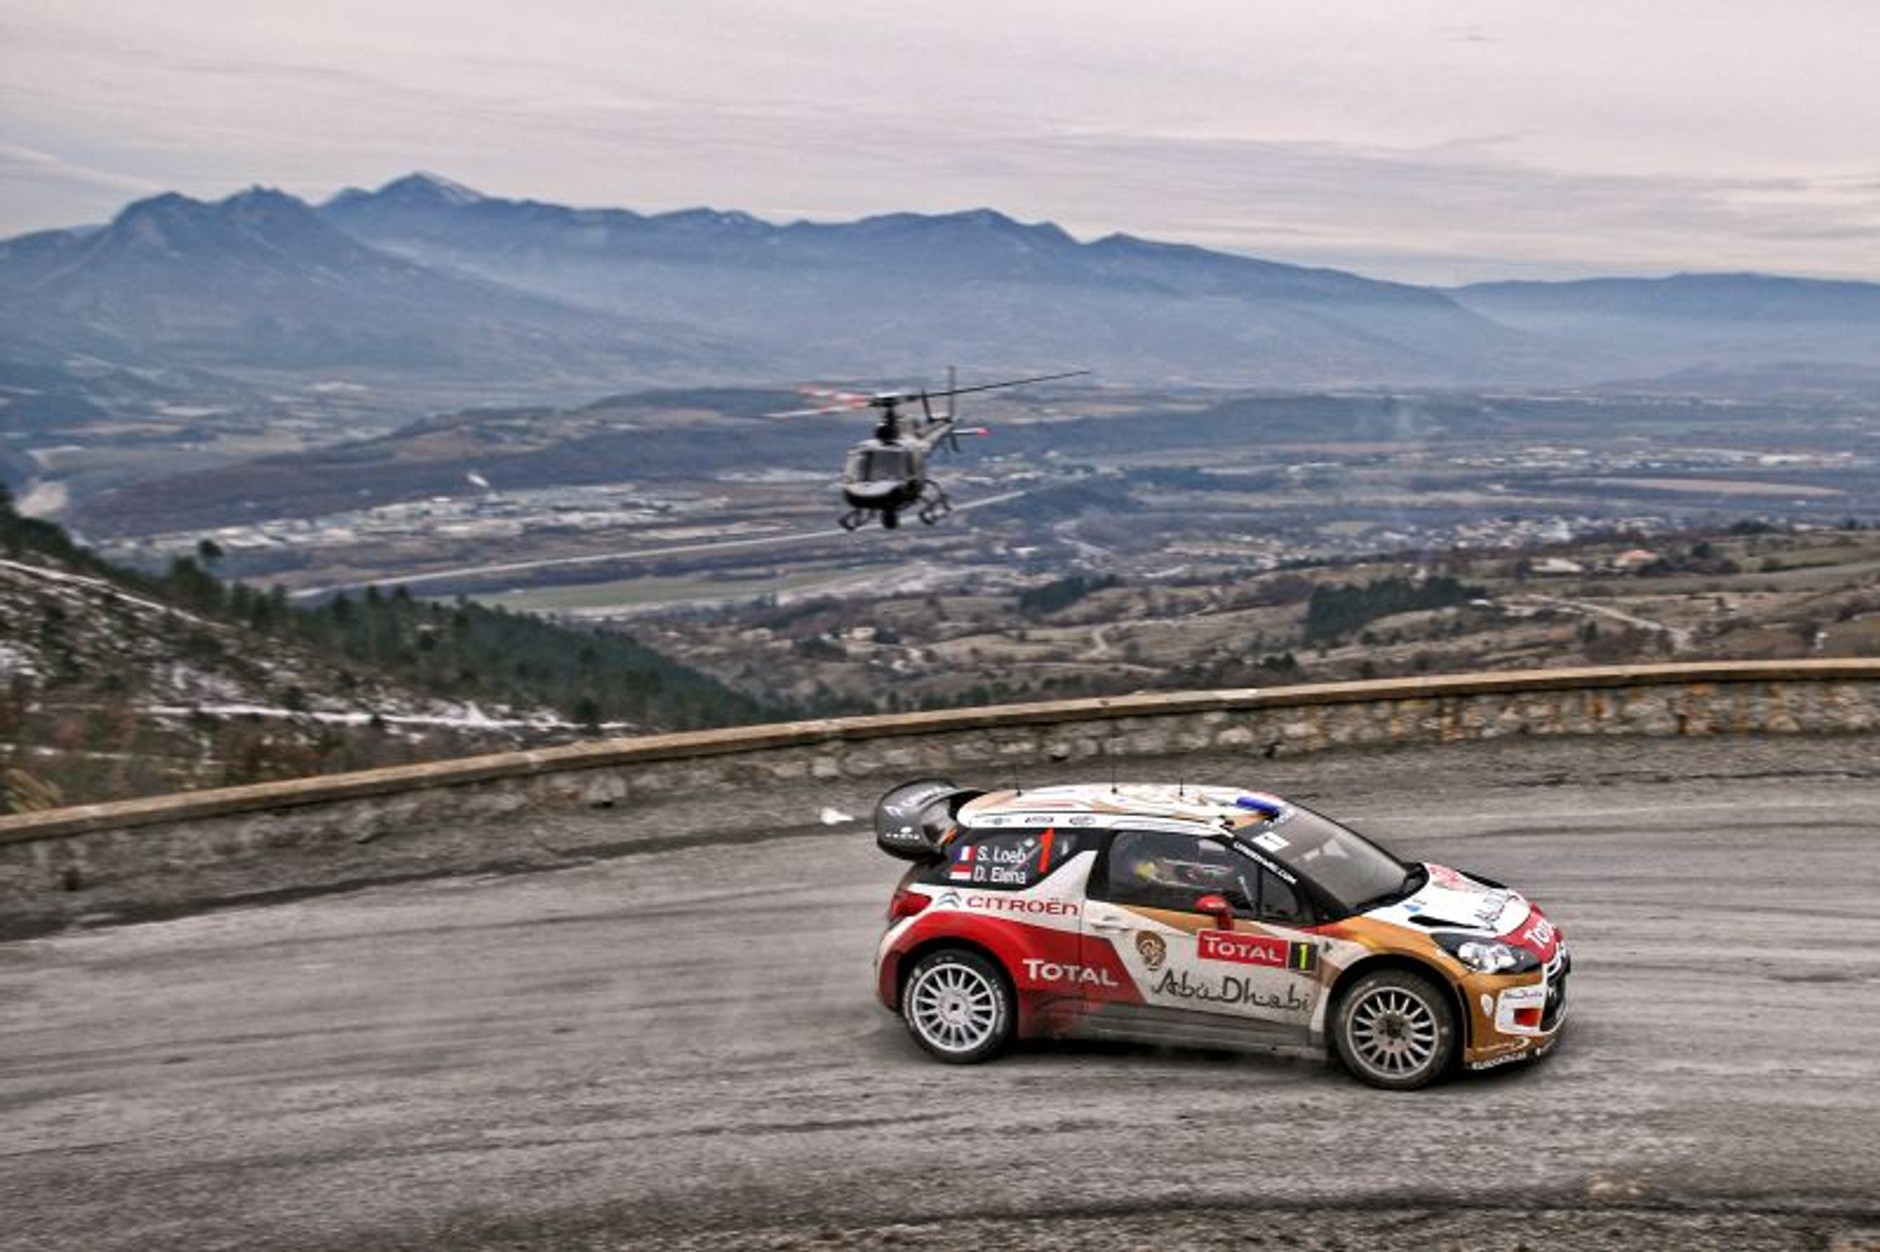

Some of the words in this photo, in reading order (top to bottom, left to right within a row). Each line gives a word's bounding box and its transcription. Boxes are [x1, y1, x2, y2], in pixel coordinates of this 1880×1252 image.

[977, 845, 990, 861] S.
[993, 847, 1027, 864] Loeb
[973, 865, 988, 882] D.
[990, 866, 1027, 884] Elena
[1203, 935, 1283, 963] TOTAL
[1022, 957, 1119, 986] TOTAL
